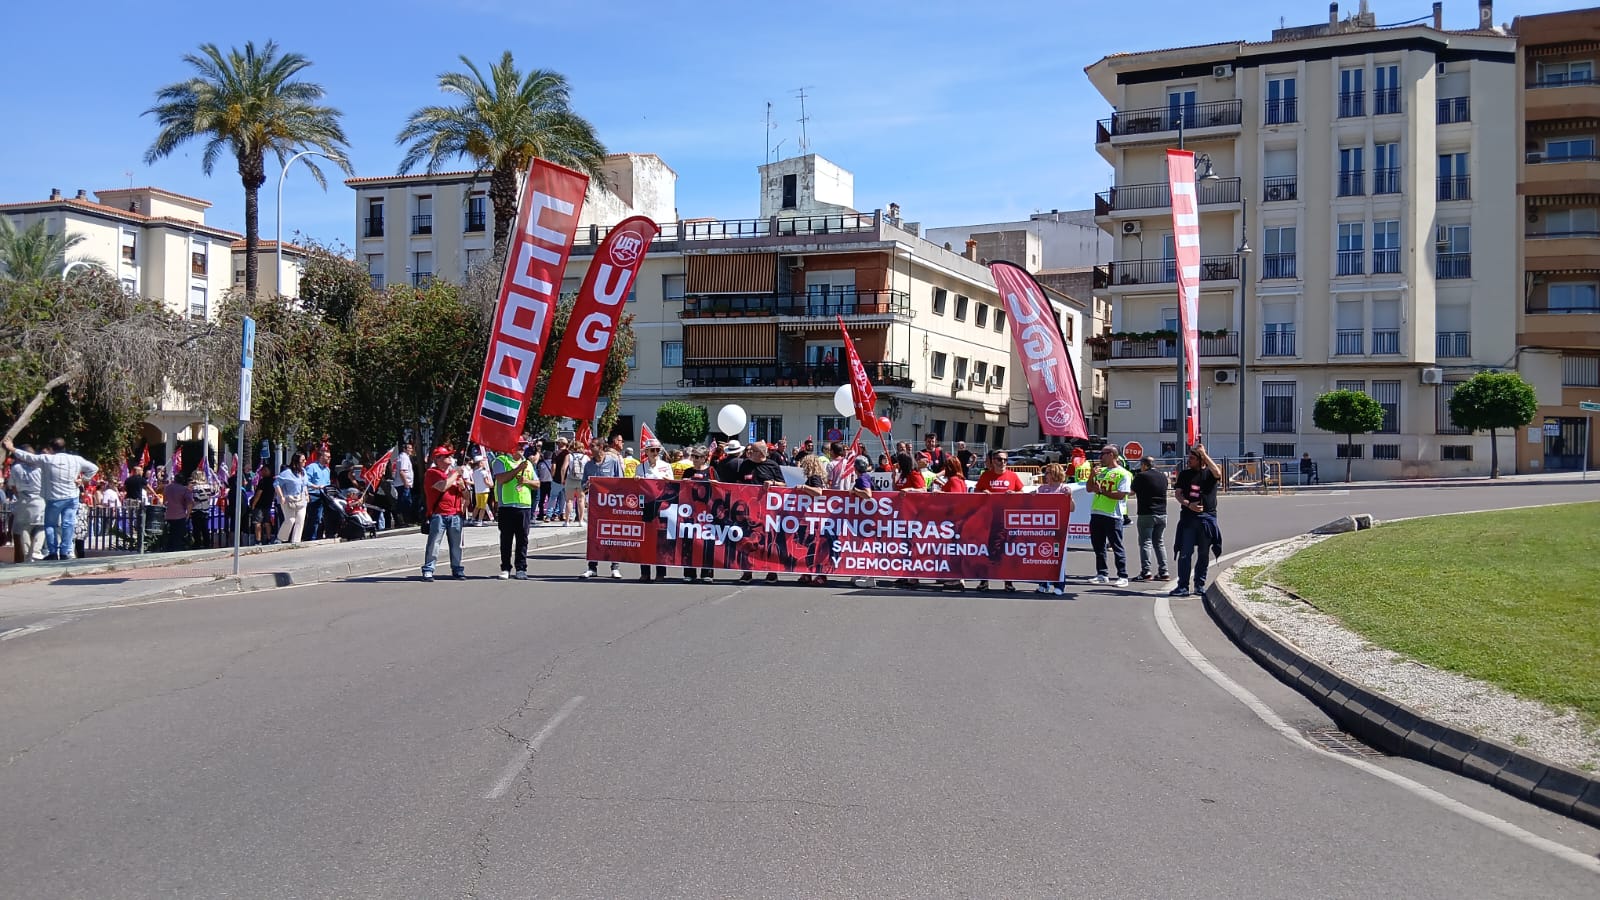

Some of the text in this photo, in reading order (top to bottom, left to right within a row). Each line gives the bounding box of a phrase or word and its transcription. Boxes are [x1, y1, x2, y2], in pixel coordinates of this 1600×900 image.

[615, 235, 641, 253] UGT
[488, 190, 575, 393] CCOO
[567, 264, 632, 398] UGT
[1125, 448, 1142, 456] STOP
[597, 492, 625, 507] UGT
[766, 492, 898, 520] DERECHOS,
[612, 508, 644, 516] Extremadura
[697, 510, 714, 523] de
[765, 514, 960, 539] NO TRINCHERAS.
[1008, 513, 1056, 526] CCOO
[600, 523, 641, 537] CCOO
[679, 522, 743, 546] mayo
[1008, 529, 1056, 537] extremadura
[600, 539, 641, 548] extremadura
[832, 540, 988, 557] SALARIOS, VIVIENDA
[1004, 542, 1037, 556] UGT
[831, 556, 950, 572] Y DEMOCRACIA
[1022, 557, 1059, 565] Extremadura
